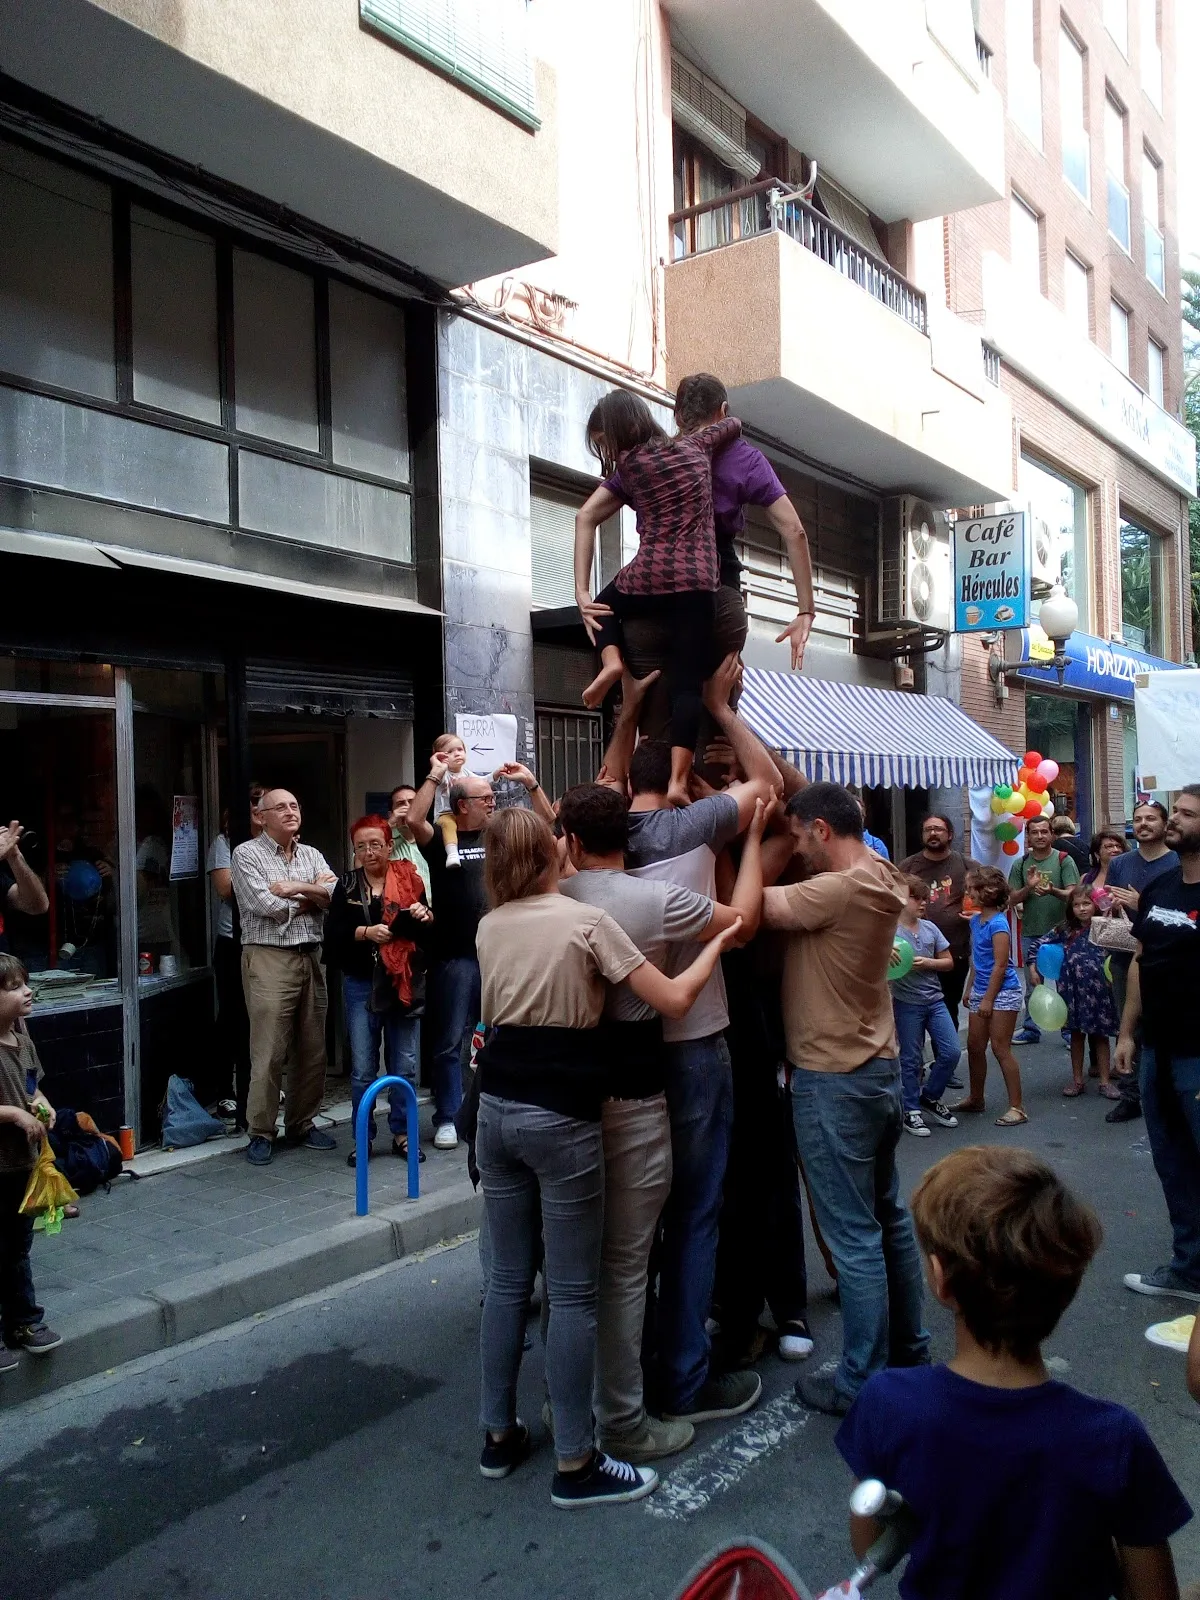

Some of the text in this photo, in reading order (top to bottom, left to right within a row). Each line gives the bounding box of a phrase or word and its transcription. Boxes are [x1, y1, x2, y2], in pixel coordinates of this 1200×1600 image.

[965, 518, 1015, 544] Café
[968, 549, 1011, 568] Bar
[961, 570, 1020, 602] Hércules
[463, 719, 496, 738] BARRA
